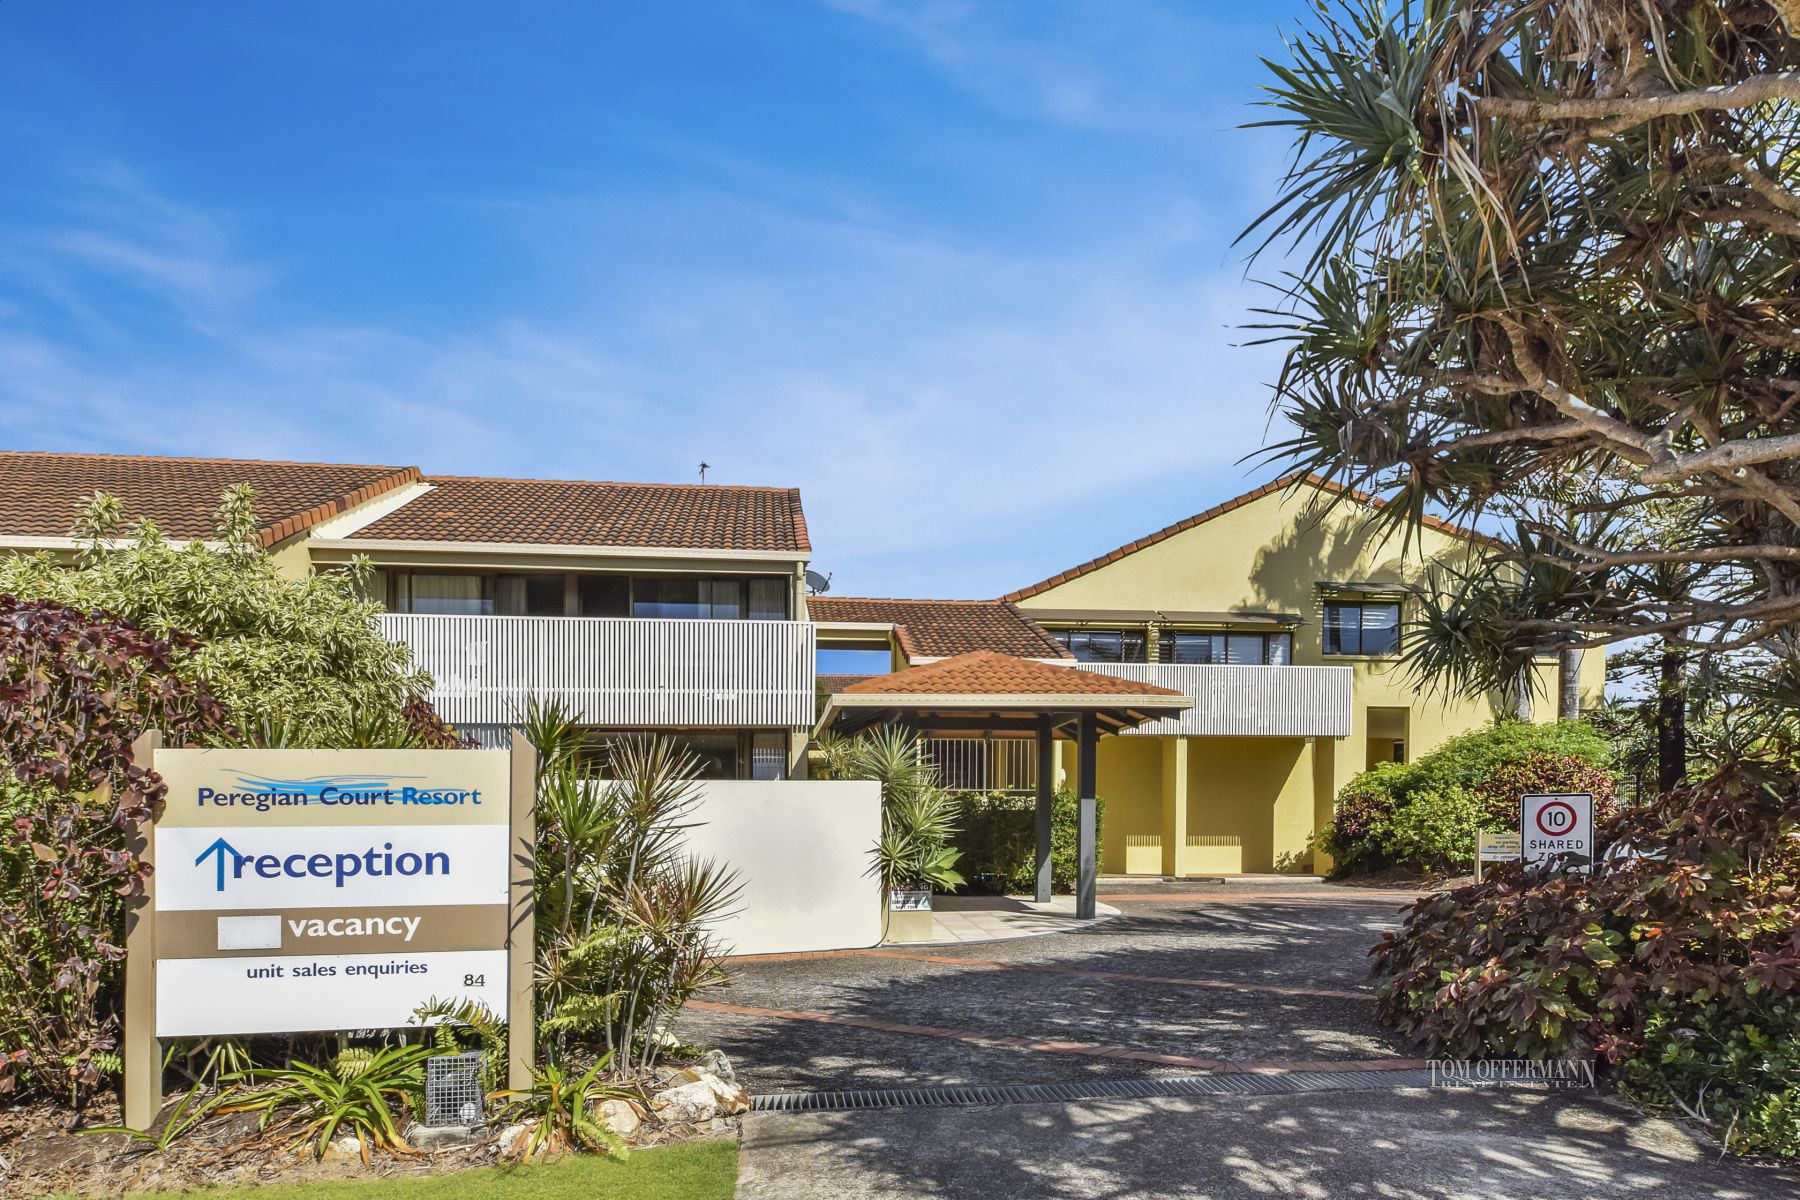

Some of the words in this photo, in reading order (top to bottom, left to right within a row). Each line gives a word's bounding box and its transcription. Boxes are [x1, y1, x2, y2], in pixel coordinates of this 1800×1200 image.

[197, 787, 308, 812] Peregian
[319, 786, 395, 806] Court
[402, 787, 482, 806] Resort
[1547, 811, 1566, 827] 10
[1529, 839, 1584, 850] SHARED
[233, 842, 450, 888] reception
[288, 916, 422, 942] vacancy
[246, 962, 284, 979] unit
[292, 961, 337, 978] sales
[345, 960, 428, 979] enquiries
[463, 973, 486, 987] 84
